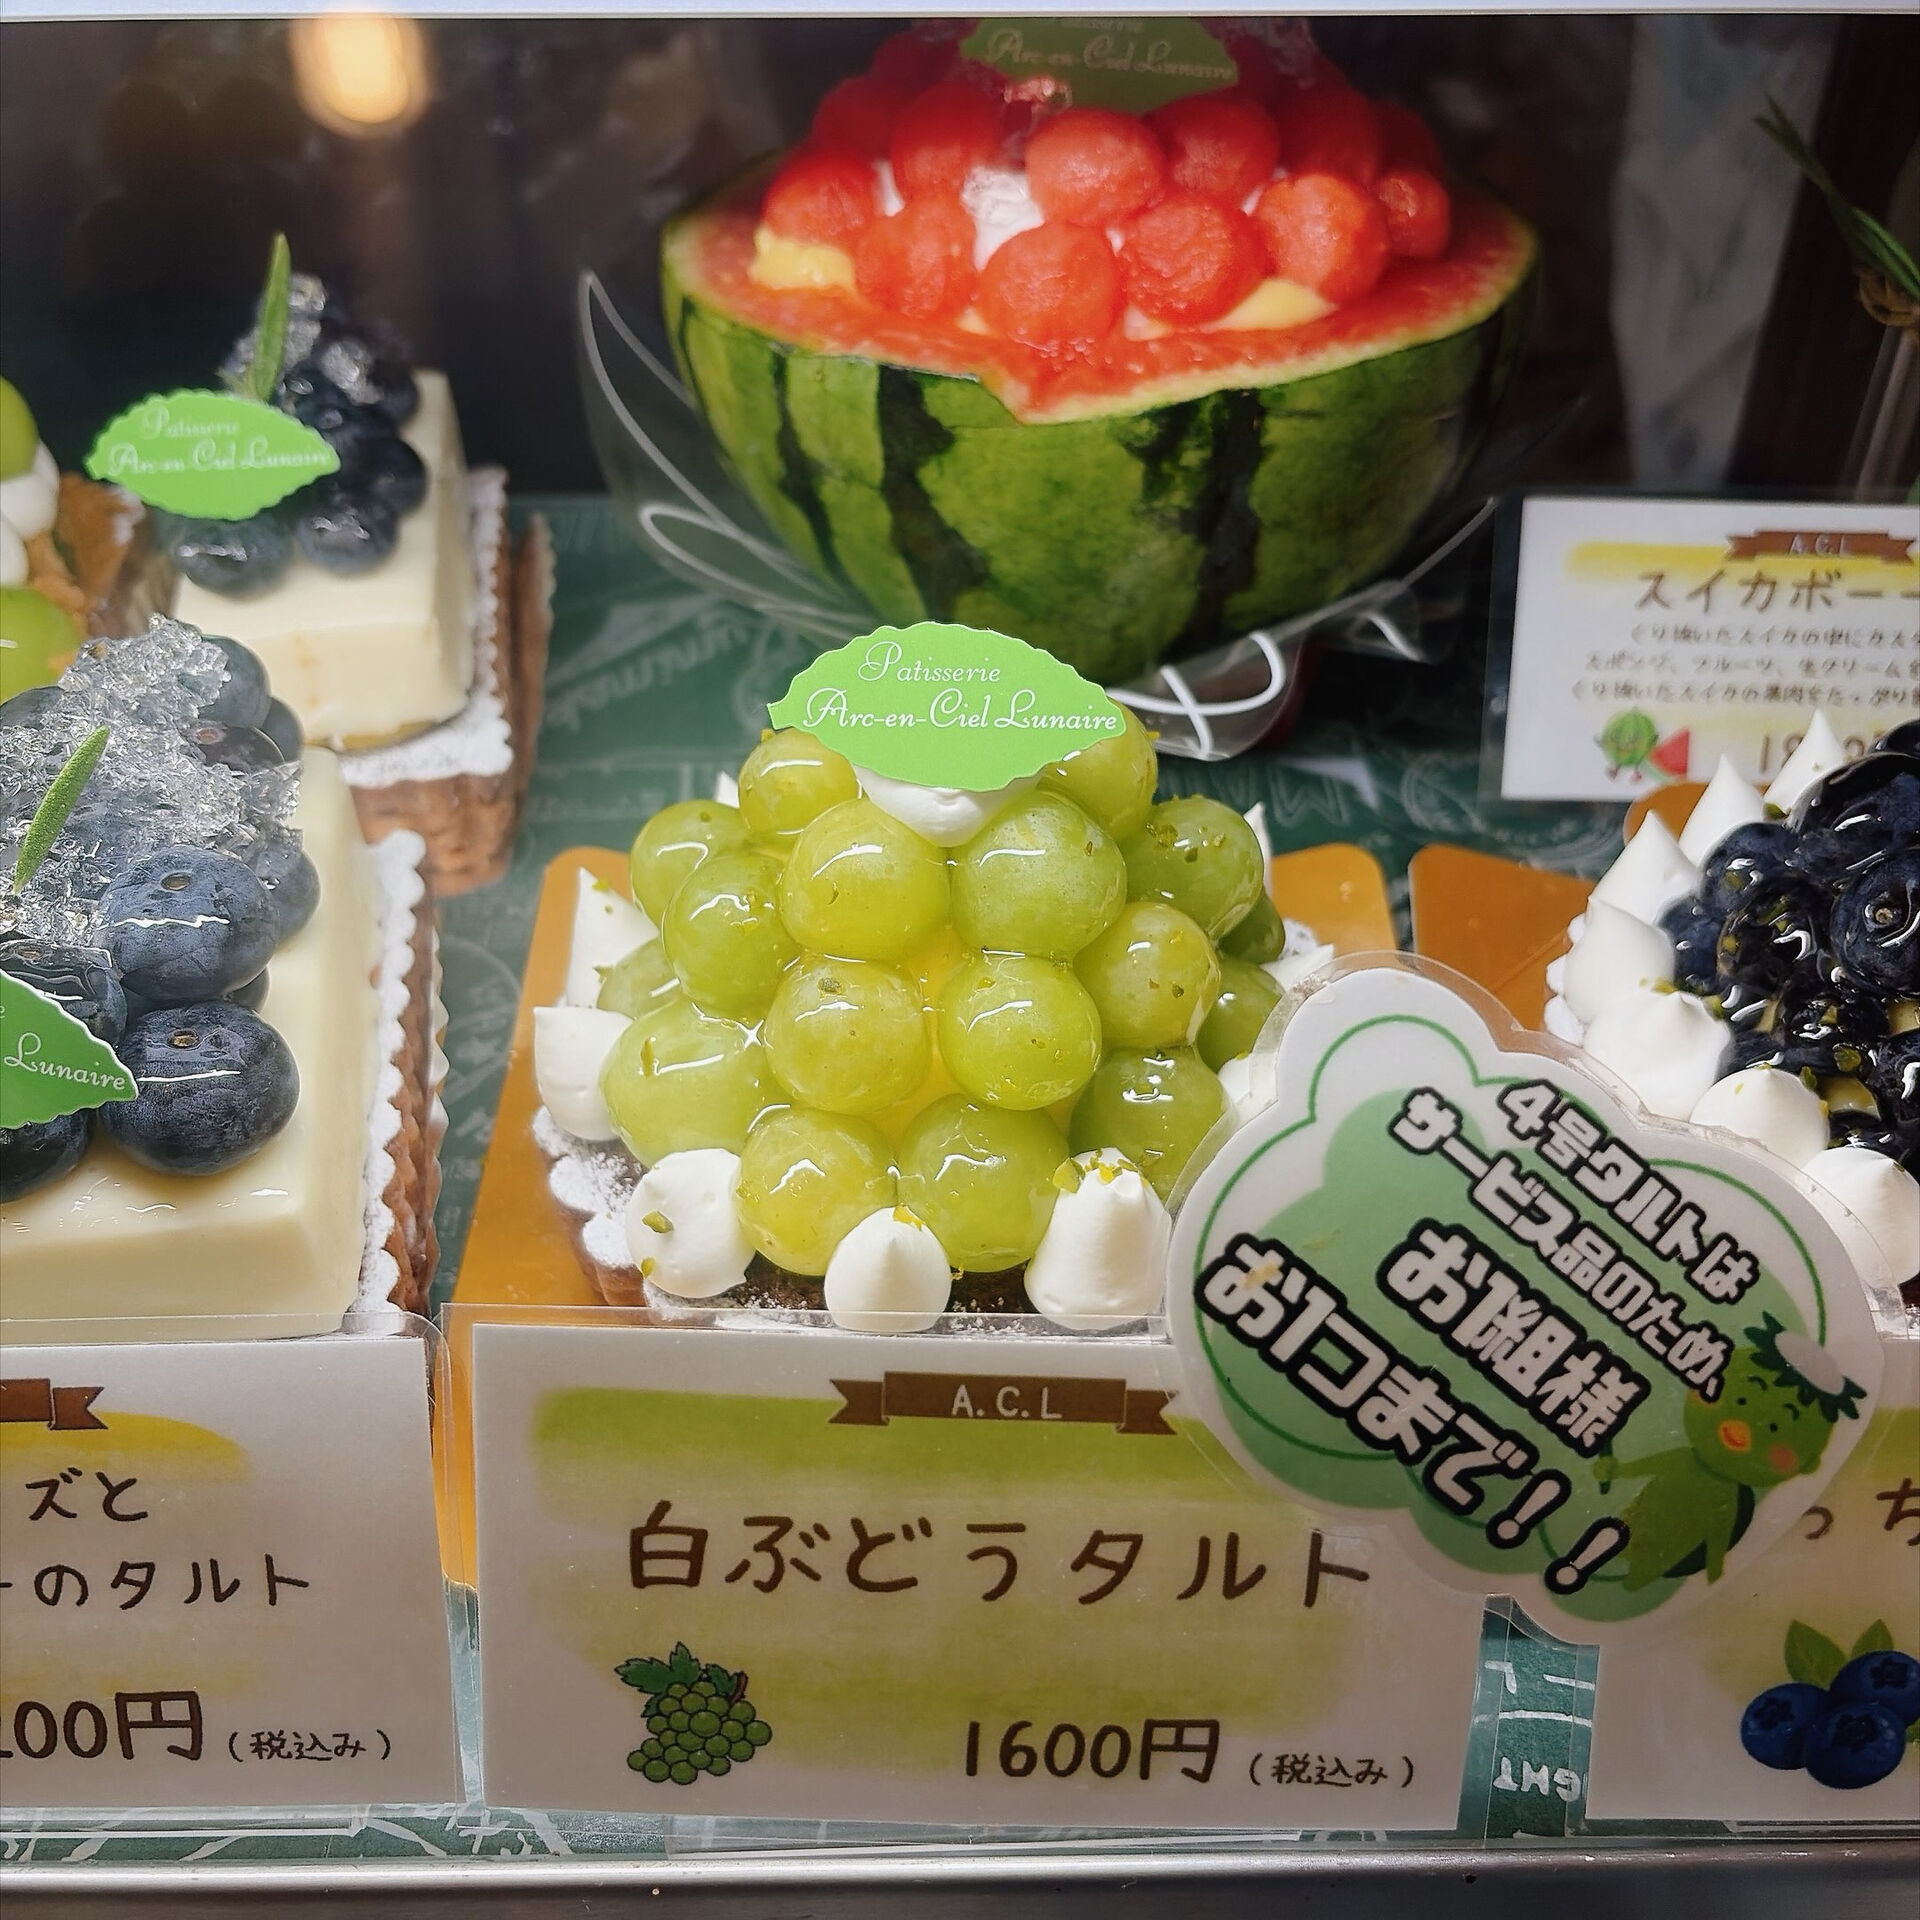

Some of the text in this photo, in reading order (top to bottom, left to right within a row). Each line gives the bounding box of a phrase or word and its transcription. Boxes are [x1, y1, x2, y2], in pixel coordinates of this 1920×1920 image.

[857, 640, 1001, 682] Patisserie
[802, 687, 1117, 731] Arc-en-Ciel Lunaire
[4, 1032, 126, 1090] Lunaire
[1497, 1079, 1760, 1305] 4号タルトは
[1389, 1087, 1734, 1403] サービス品のため、
[1377, 1219, 1651, 1457] お1組様
[951, 1385, 1063, 1420] A.C.L
[25, 1467, 149, 1522] ズと
[630, 1500, 1370, 1608] 白ぶどうタルト
[0, 1691, 203, 1761] 00円
[965, 1718, 1221, 1784] 1600円
